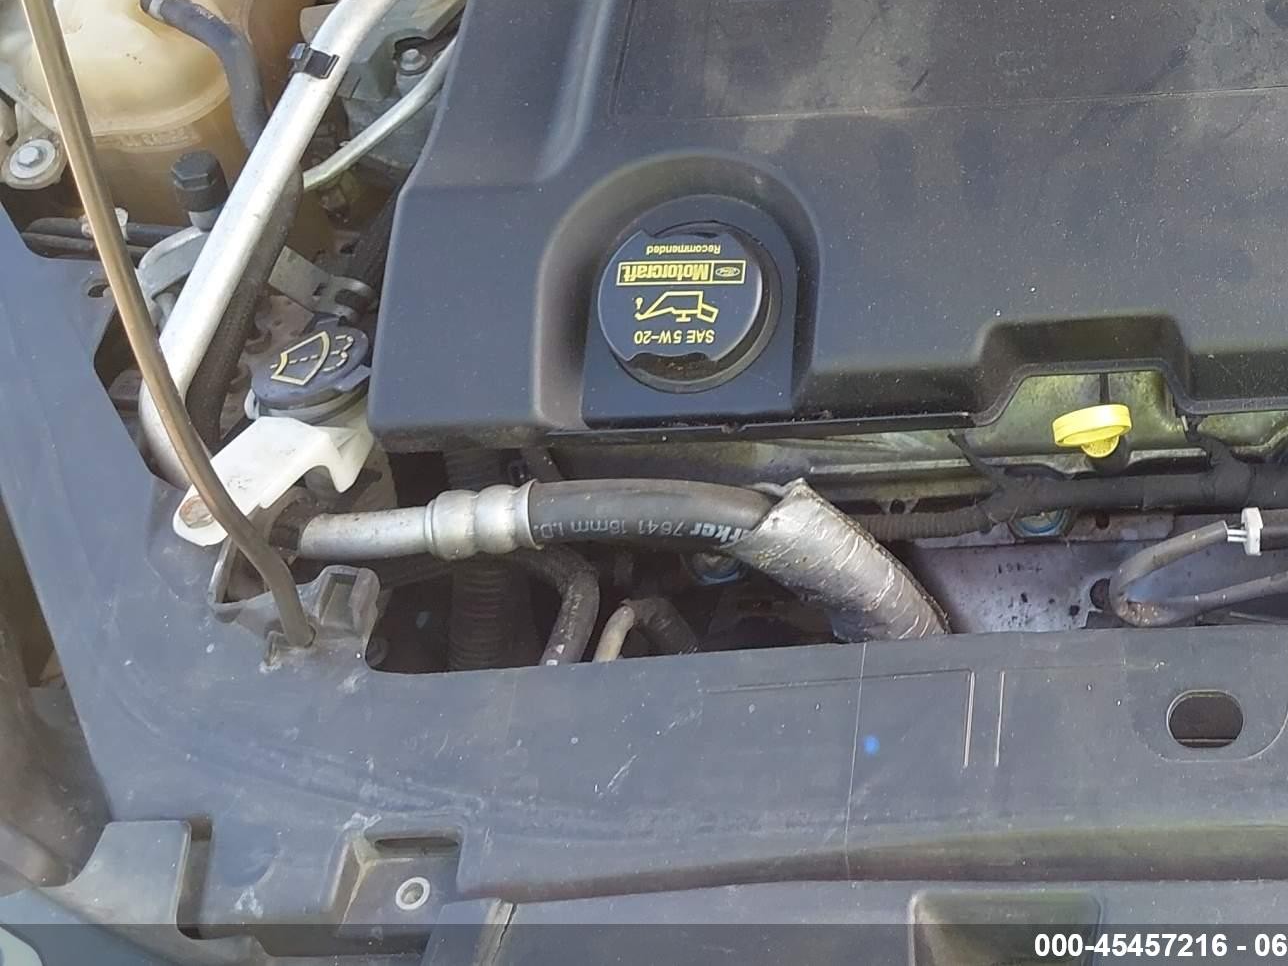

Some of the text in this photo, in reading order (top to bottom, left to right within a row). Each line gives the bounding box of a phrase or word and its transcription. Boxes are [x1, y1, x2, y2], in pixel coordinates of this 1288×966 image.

[645, 244, 721, 256] Recommended
[622, 263, 709, 283] Motorcraft
[633, 328, 715, 345] SAE 5W-20
[532, 520, 565, 539] I.D.
[569, 518, 628, 534] 16mm
